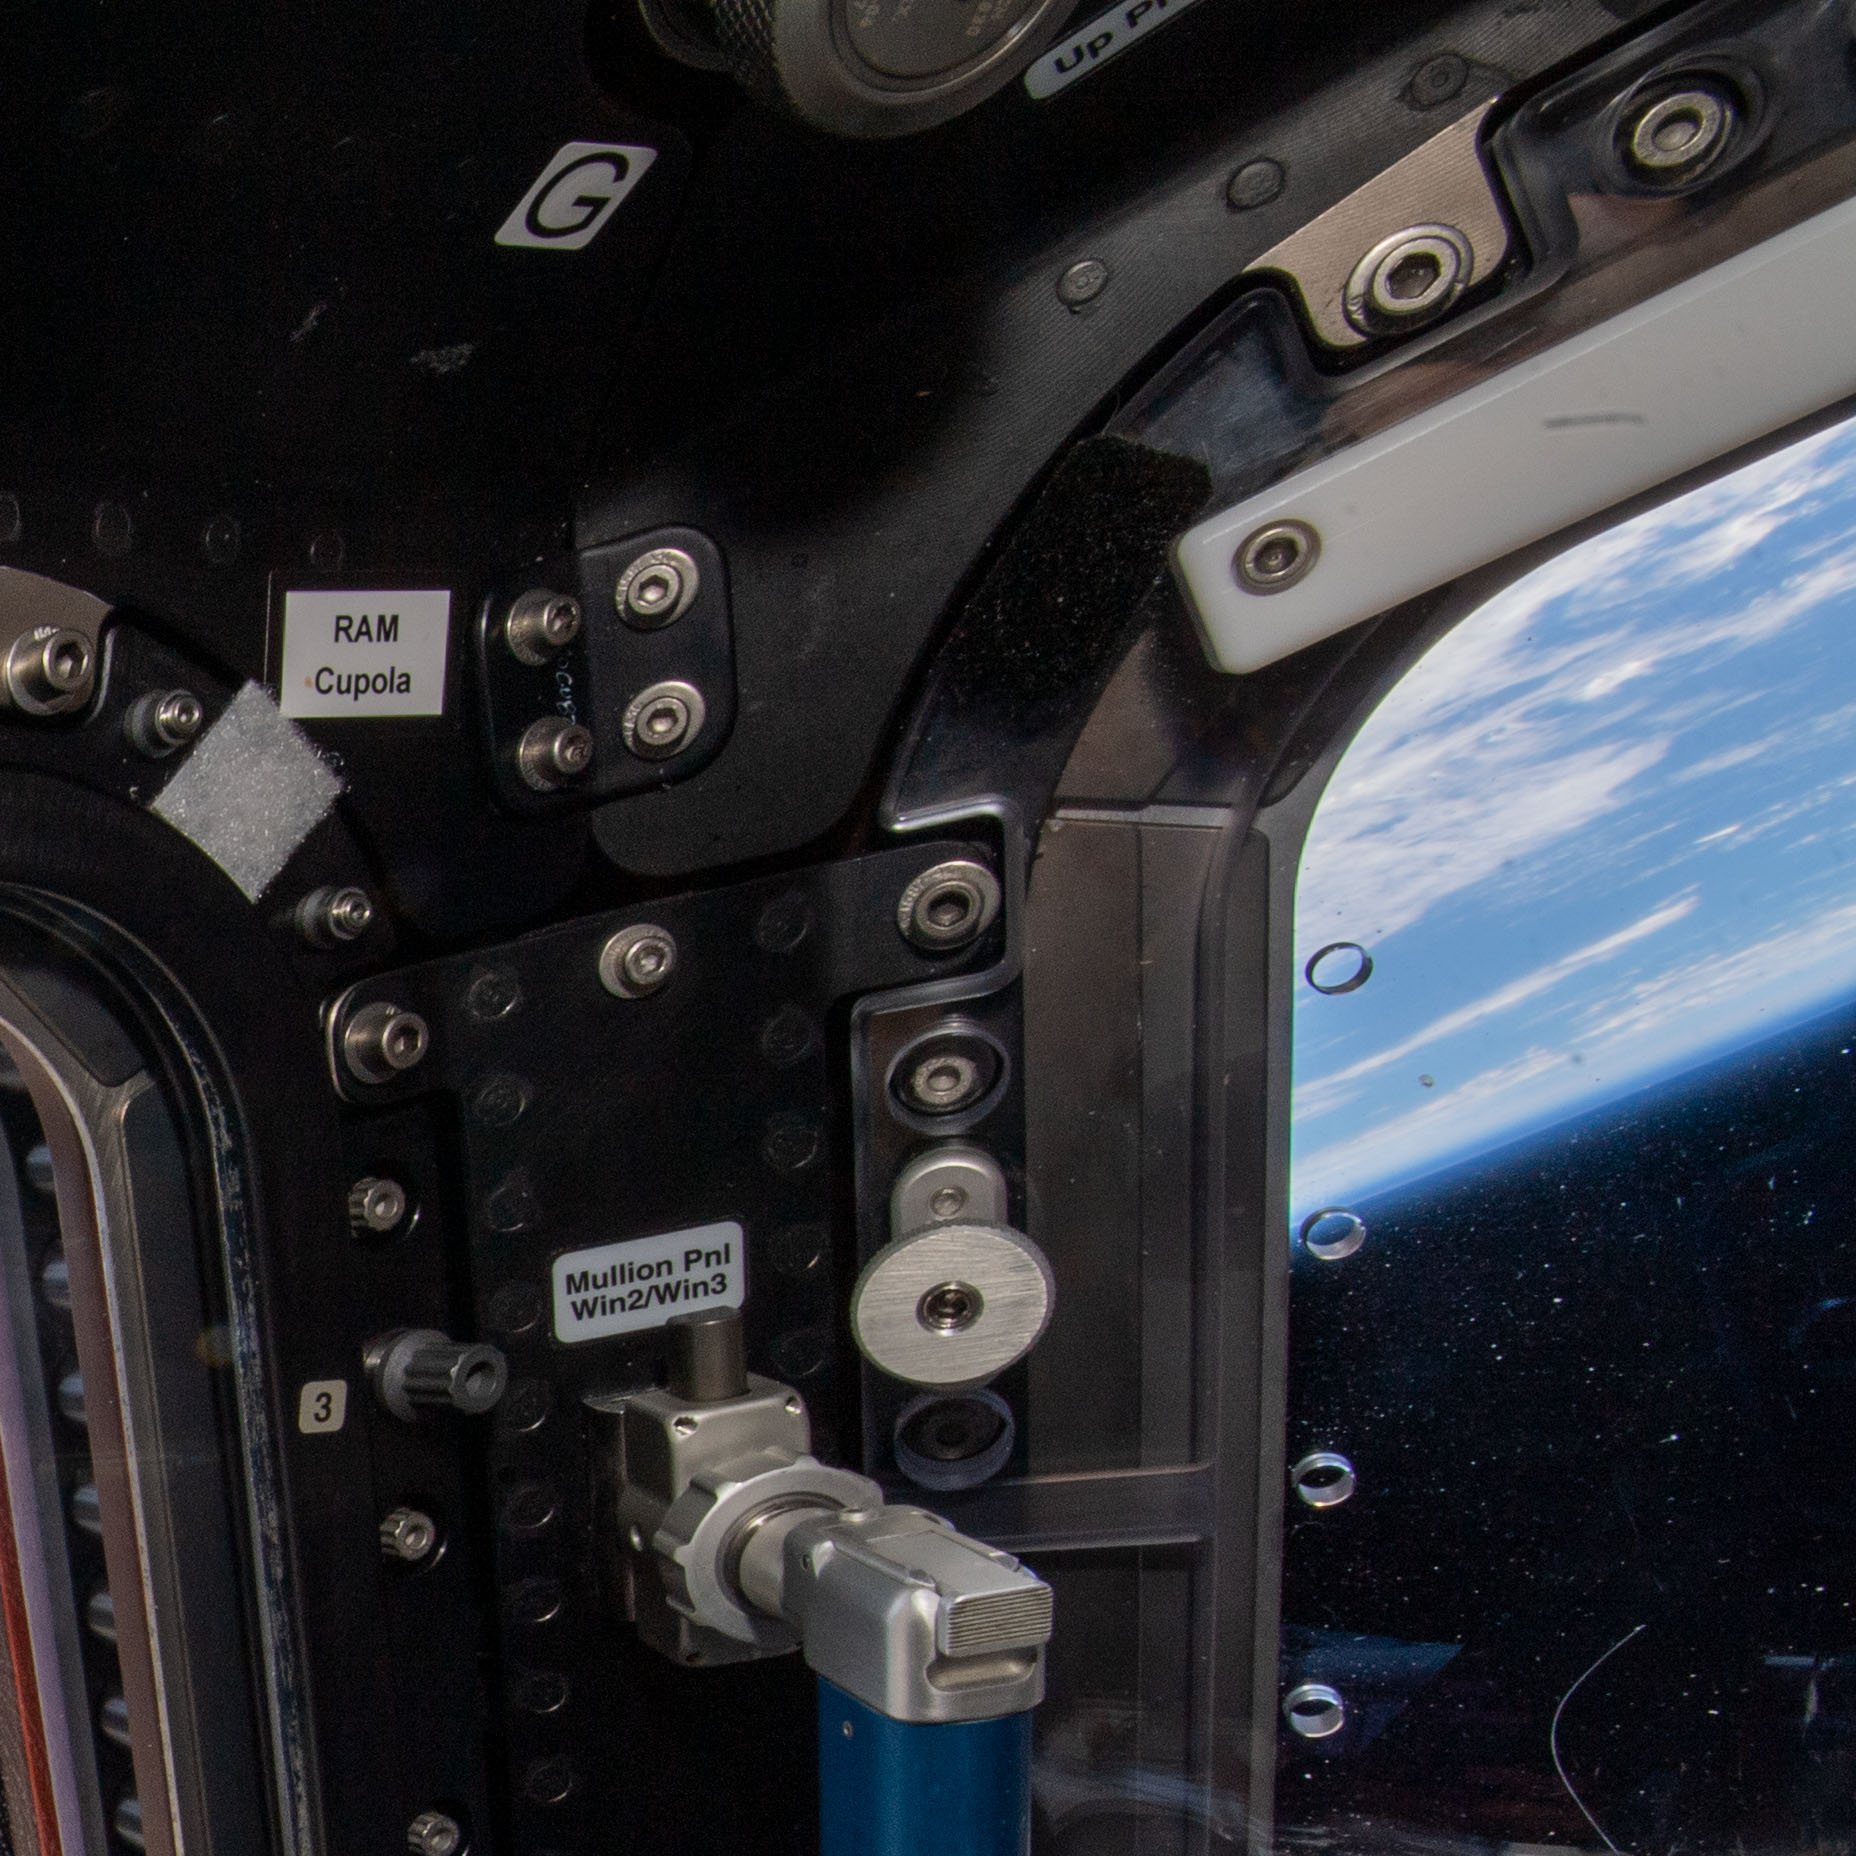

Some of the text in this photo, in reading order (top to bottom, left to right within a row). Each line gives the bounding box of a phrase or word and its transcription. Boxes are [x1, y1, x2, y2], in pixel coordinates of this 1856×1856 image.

[525, 151, 630, 239] G
[333, 614, 400, 643] RAM
[314, 666, 411, 702] Cupola
[565, 1242, 731, 1295] Mullion Pnl
[570, 1272, 728, 1321] Win2/Win3
[313, 1391, 332, 1423] 3
